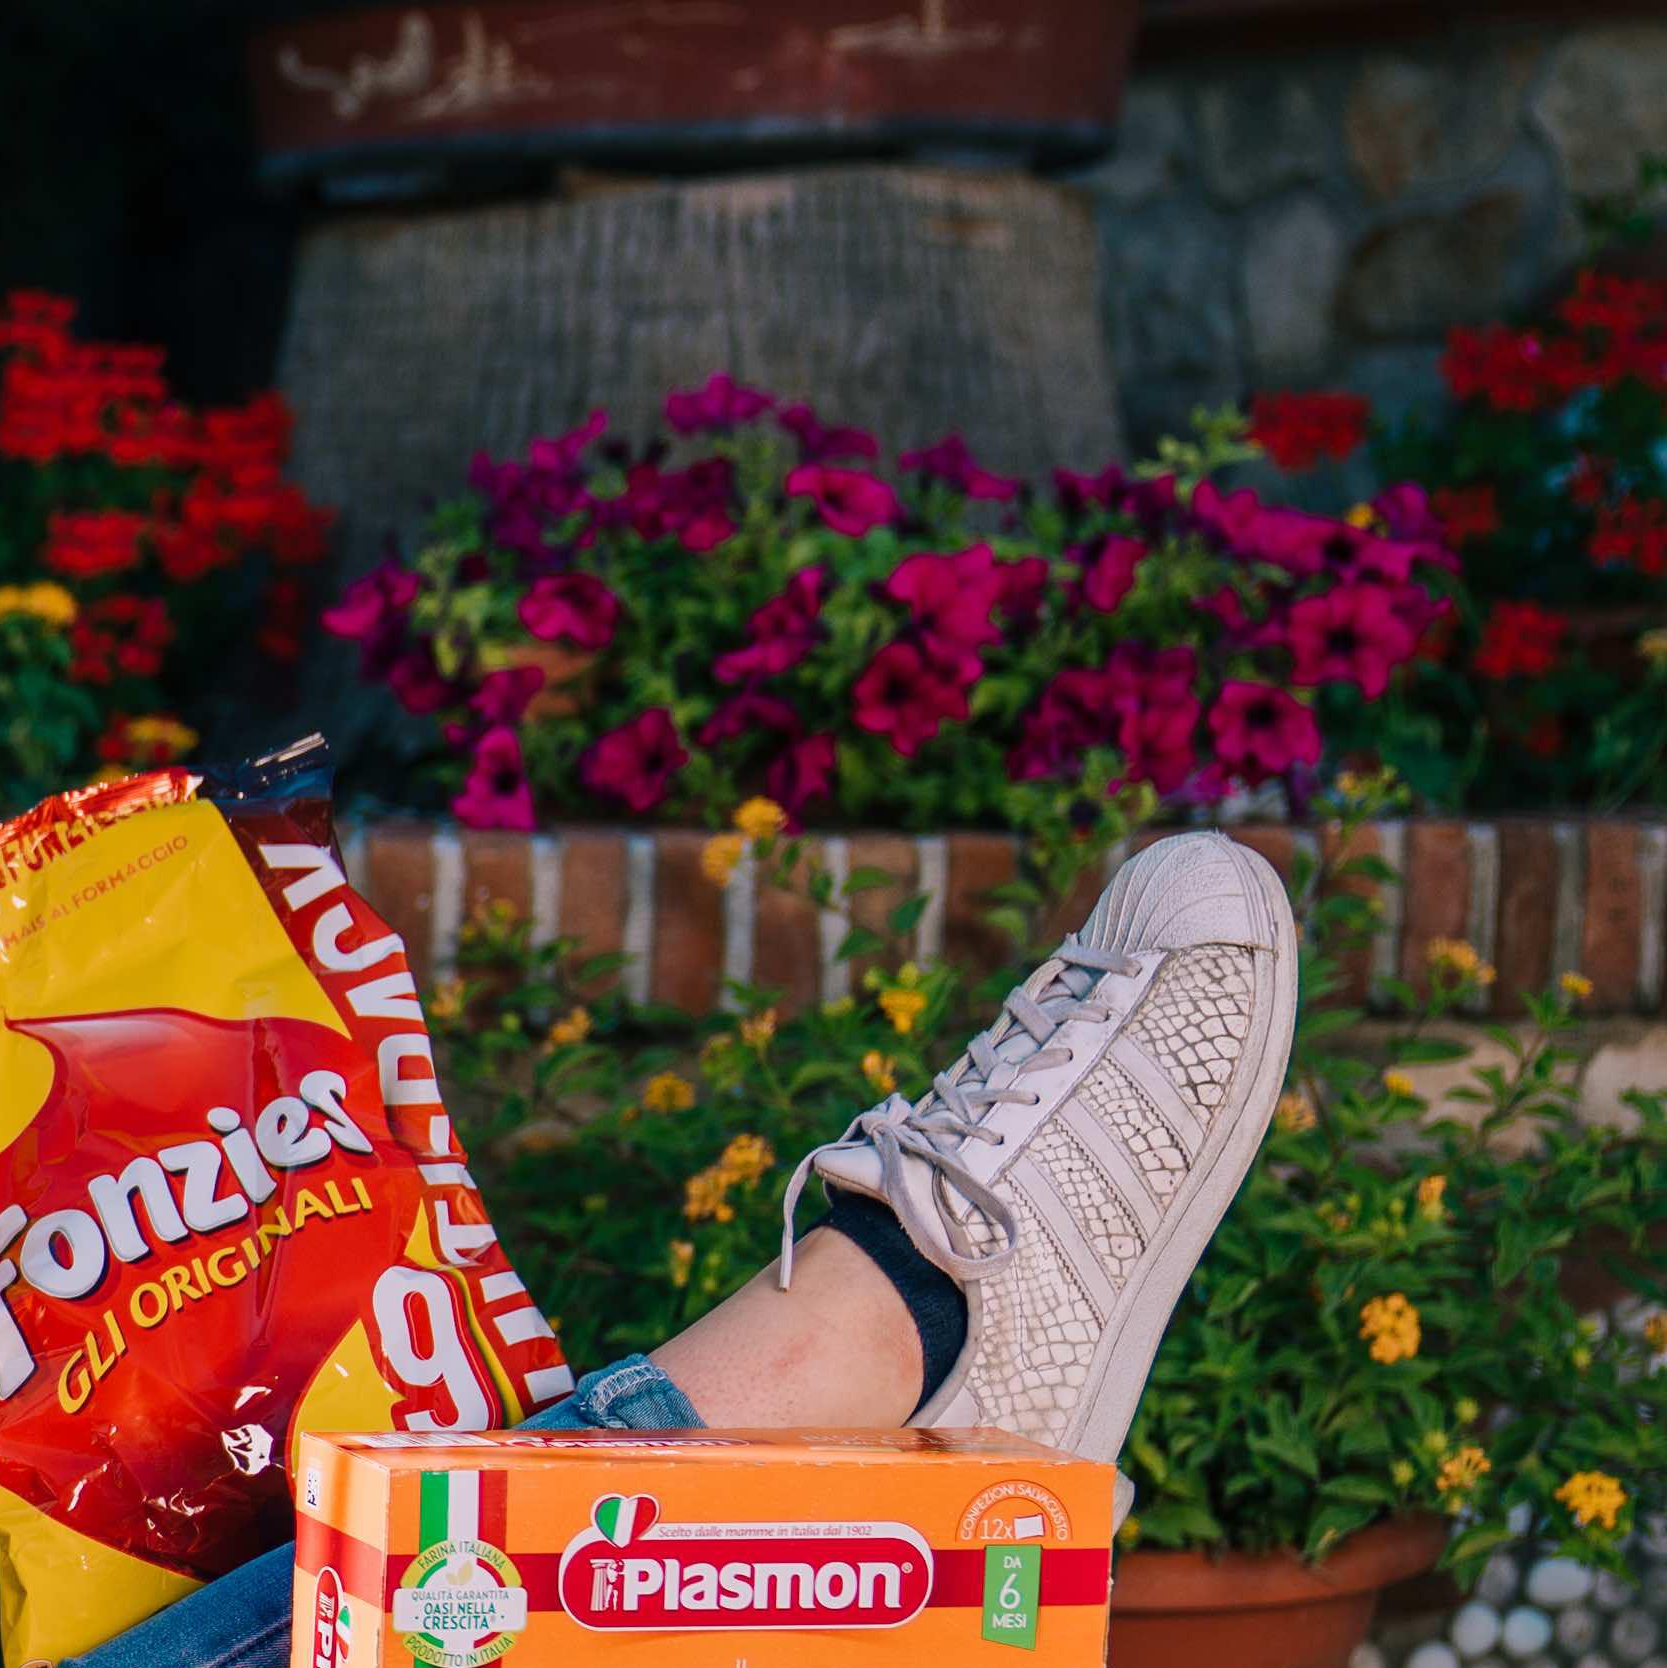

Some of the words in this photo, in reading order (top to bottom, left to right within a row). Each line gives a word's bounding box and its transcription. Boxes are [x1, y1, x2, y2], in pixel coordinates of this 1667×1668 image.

[72, 834, 188, 907] FORMAGGIO
[57, 1309, 127, 1415] GLI
[129, 1177, 374, 1330] ORIGINALI
[658, 1526, 692, 1538] Scelto
[694, 1525, 723, 1537] dalle
[725, 1528, 775, 1537] mamme
[777, 1525, 788, 1536] in
[823, 1525, 842, 1536] dal
[846, 1525, 873, 1536] 1902
[416, 1543, 457, 1569] FARINA
[459, 1540, 507, 1570] ITALIANA
[1003, 1556, 1022, 1569] DA
[456, 1590, 509, 1601] GARANTITA
[621, 1558, 903, 1611] Plasmon
[999, 1573, 1021, 1610] 6
[424, 1602, 453, 1615] OASI
[457, 1602, 496, 1615] NELLA
[422, 1615, 490, 1630] CRESCITA
[992, 1614, 1027, 1629] MESI
[406, 1635, 463, 1668] PRODOTTO
[480, 1636, 514, 1662] ITALIA
